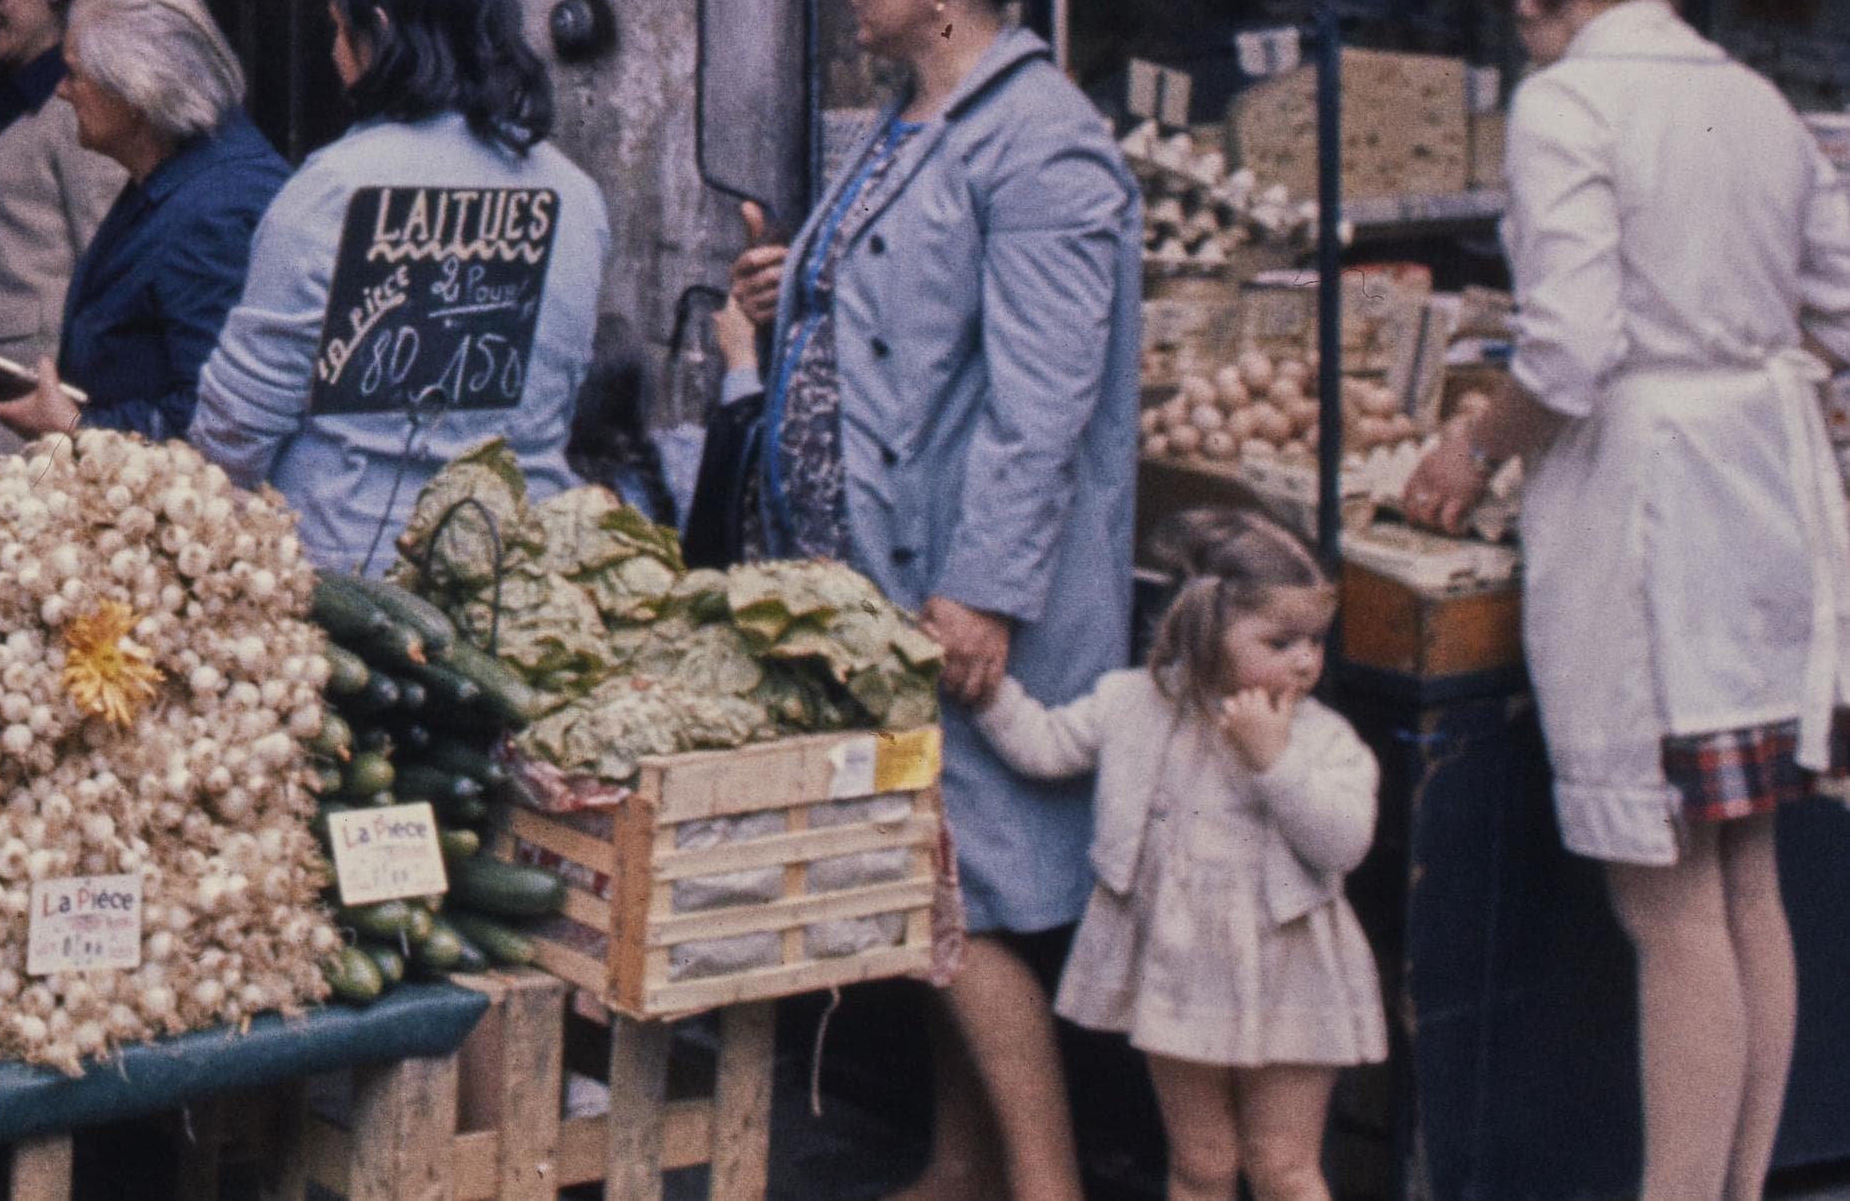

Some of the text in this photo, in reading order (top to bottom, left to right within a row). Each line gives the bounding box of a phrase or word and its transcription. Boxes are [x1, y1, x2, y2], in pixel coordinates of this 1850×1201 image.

[373, 189, 552, 243] LAITUES
[361, 326, 420, 395] 80
[342, 824, 371, 852] La
[41, 892, 72, 918] La
